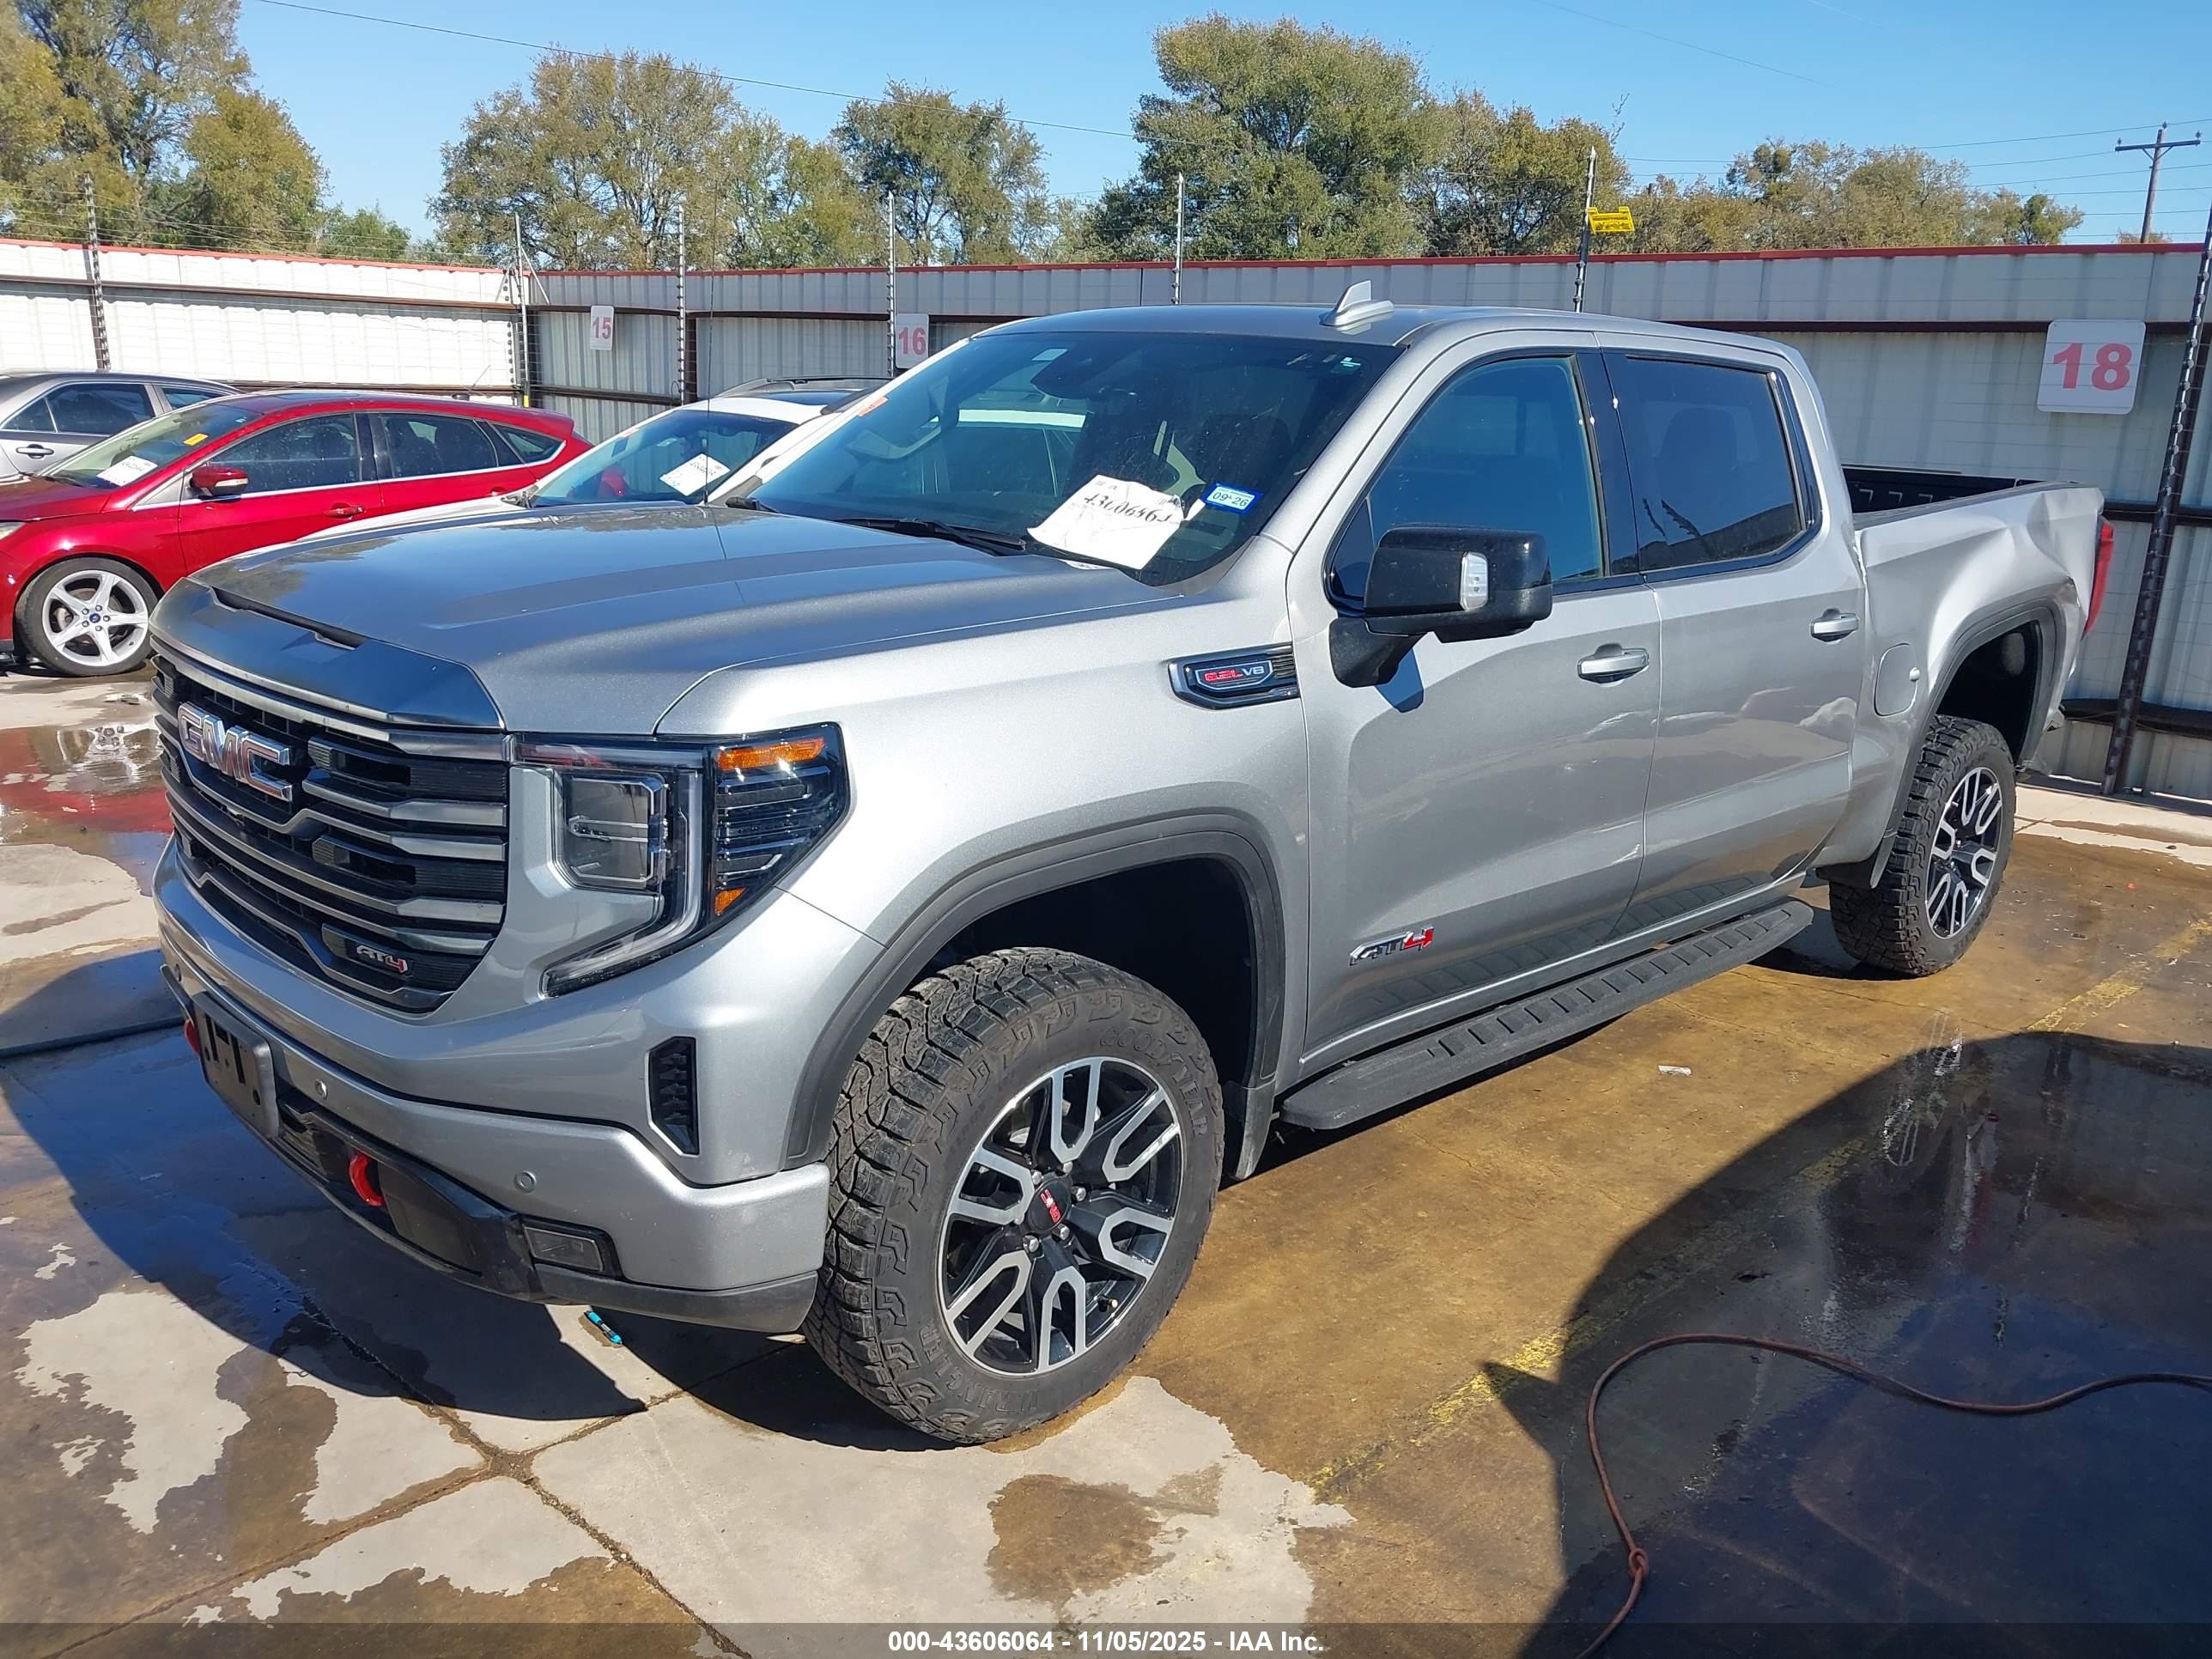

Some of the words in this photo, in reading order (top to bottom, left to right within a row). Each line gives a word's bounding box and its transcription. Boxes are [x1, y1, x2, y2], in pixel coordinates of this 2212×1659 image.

[591, 316, 612, 340] 15
[898, 326, 927, 356] 16
[2052, 343, 2133, 392] 18
[1242, 665, 1264, 676] V8
[177, 701, 294, 803] GMC
[356, 945, 409, 974] AT4
[1098, 1027, 1208, 1138] GOODYEAR
[1040, 1188, 1061, 1223] GMC
